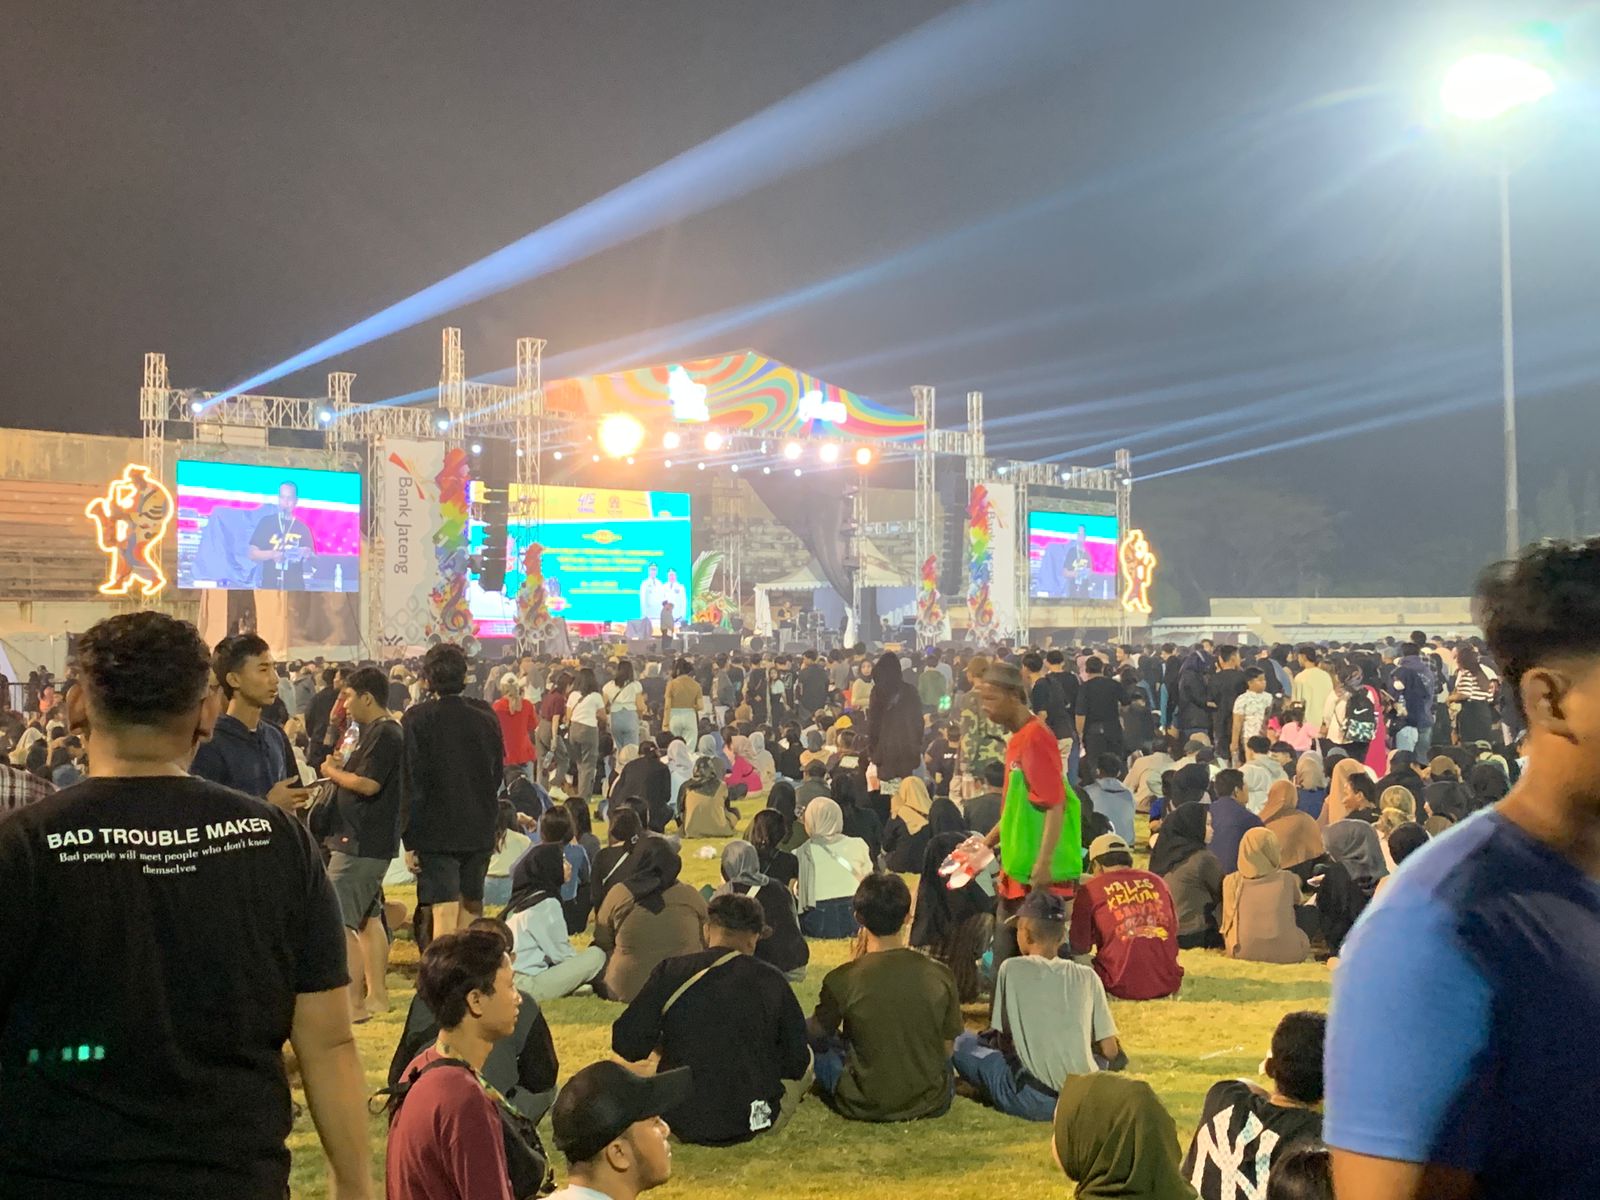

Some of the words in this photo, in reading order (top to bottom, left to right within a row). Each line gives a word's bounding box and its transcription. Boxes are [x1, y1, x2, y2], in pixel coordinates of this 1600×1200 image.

[398, 476, 413, 518] Bank
[393, 520, 413, 575] Jateng
[46, 828, 94, 849] BAD
[99, 828, 201, 846] TROUBLE
[205, 817, 273, 840] MAKER
[59, 851, 80, 863] Bad
[82, 849, 116, 863] people
[119, 849, 137, 861] will
[139, 852, 162, 862] meet
[164, 848, 199, 864] people
[201, 845, 222, 856] who
[223, 838, 247, 852] don't
[247, 837, 271, 848] know
[142, 863, 198, 875] themselves
